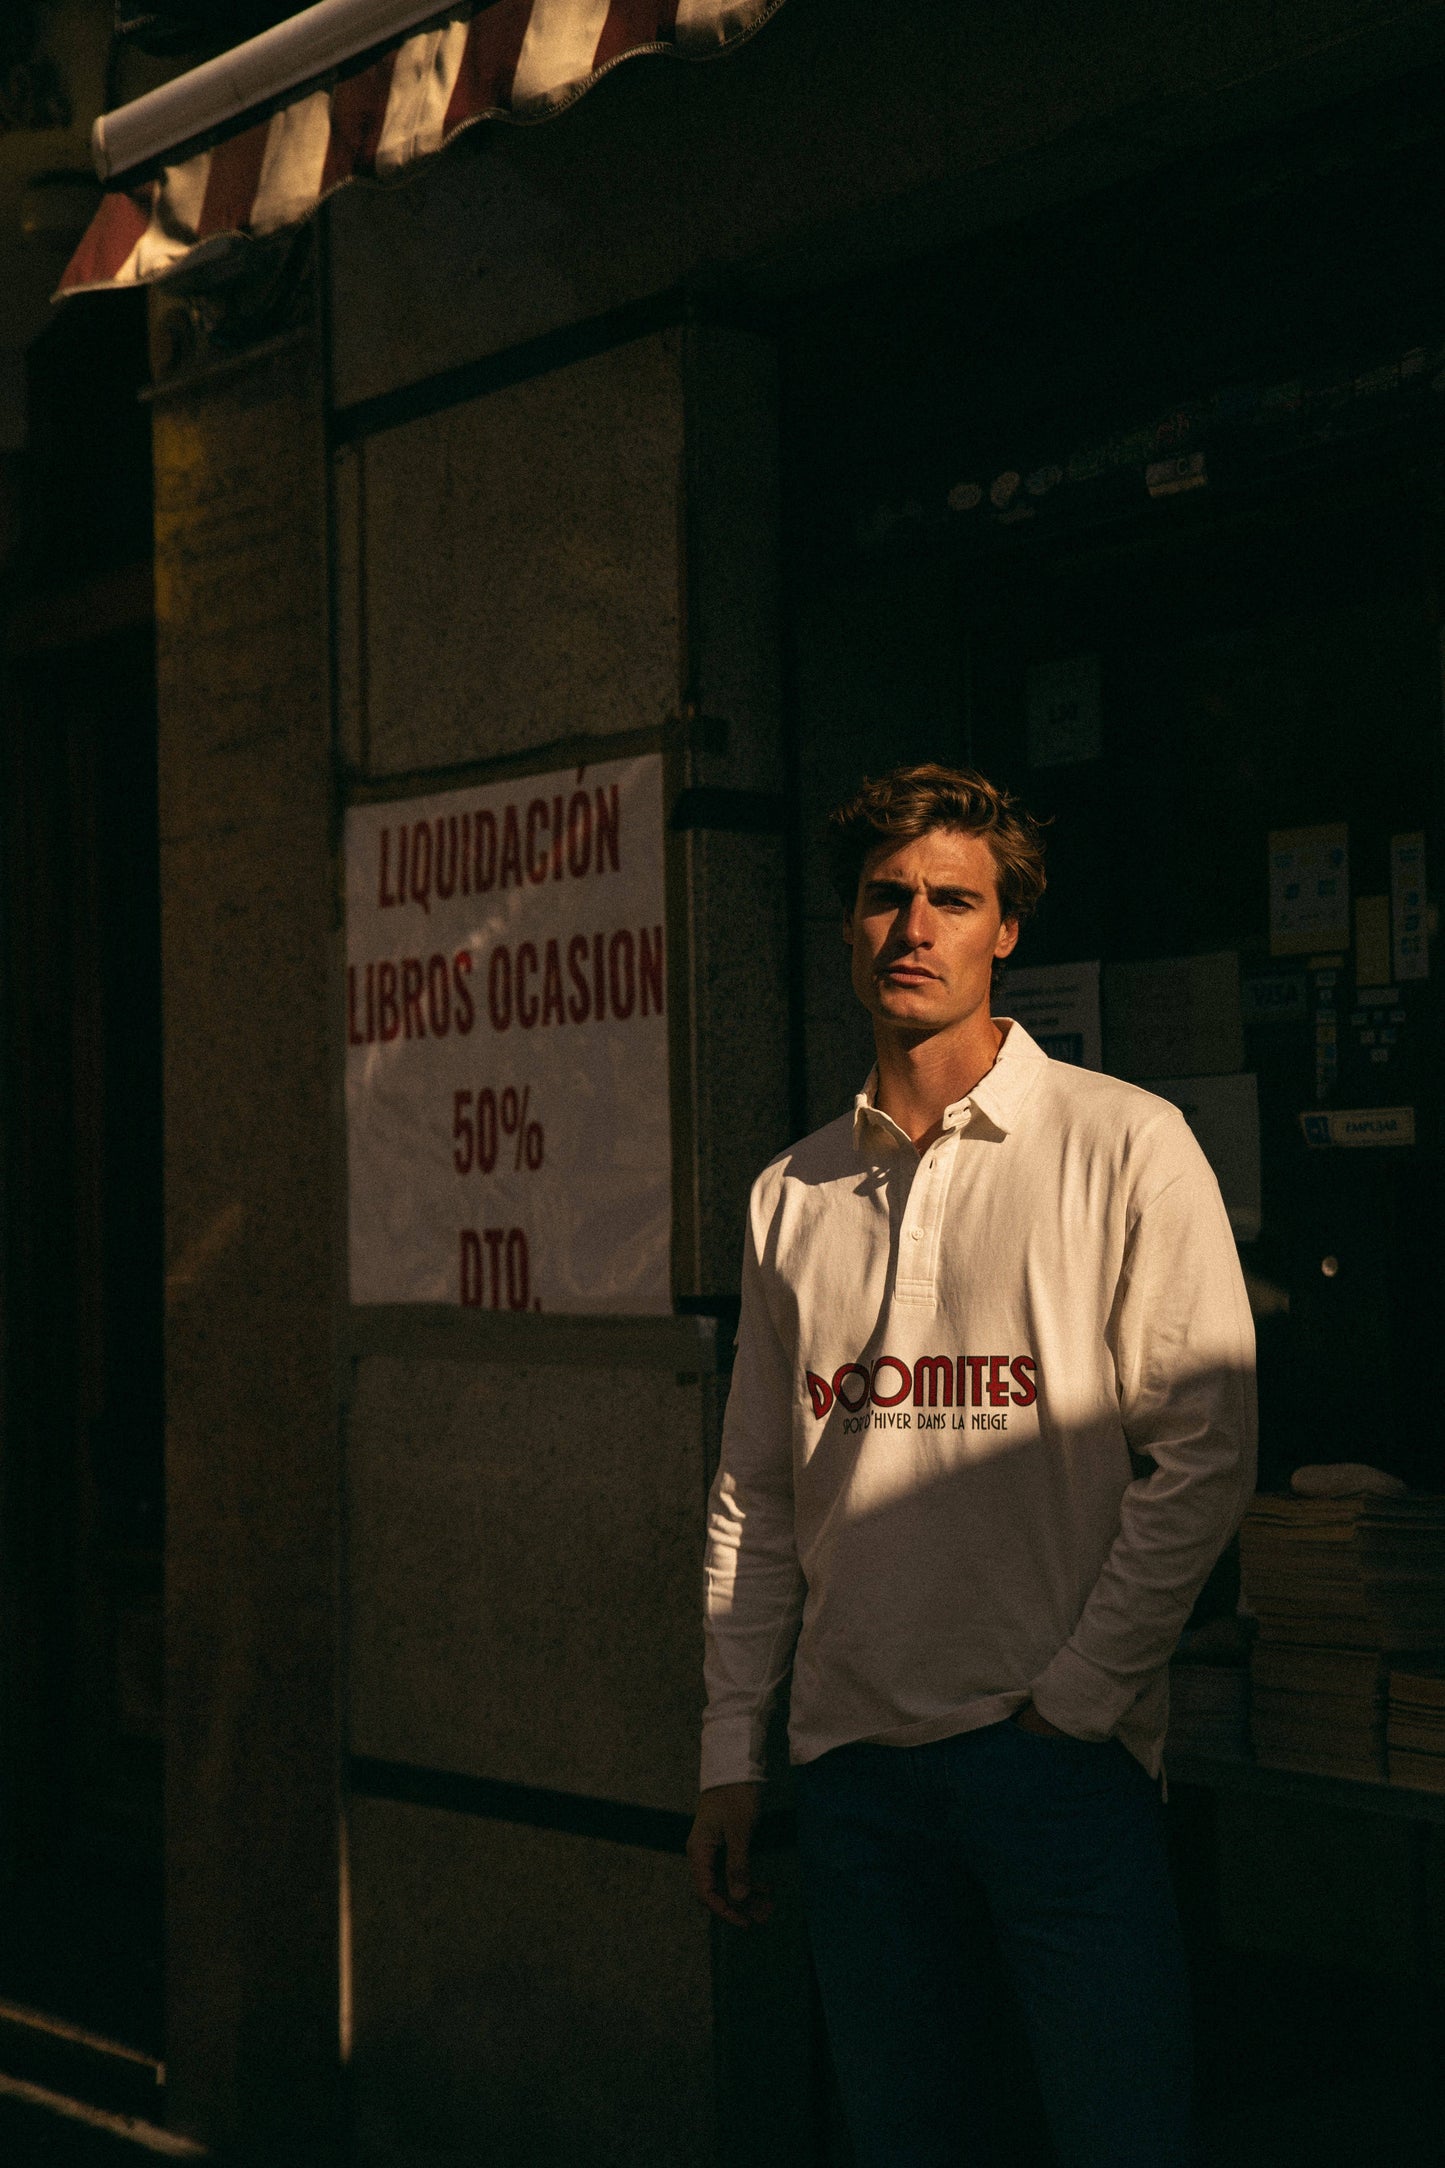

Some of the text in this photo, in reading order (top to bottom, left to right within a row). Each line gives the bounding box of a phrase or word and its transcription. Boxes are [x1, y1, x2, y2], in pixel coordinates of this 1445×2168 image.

[378, 766, 620, 914] LIQUIDACIÓN
[347, 926, 664, 1045] LIBROS OCASION
[453, 1085, 544, 1175] 50%
[806, 1355, 1038, 1420] DOOMITES
[917, 1413, 946, 1430] DANS
[952, 1413, 965, 1430] LA
[971, 1413, 1008, 1431] NEIGE
